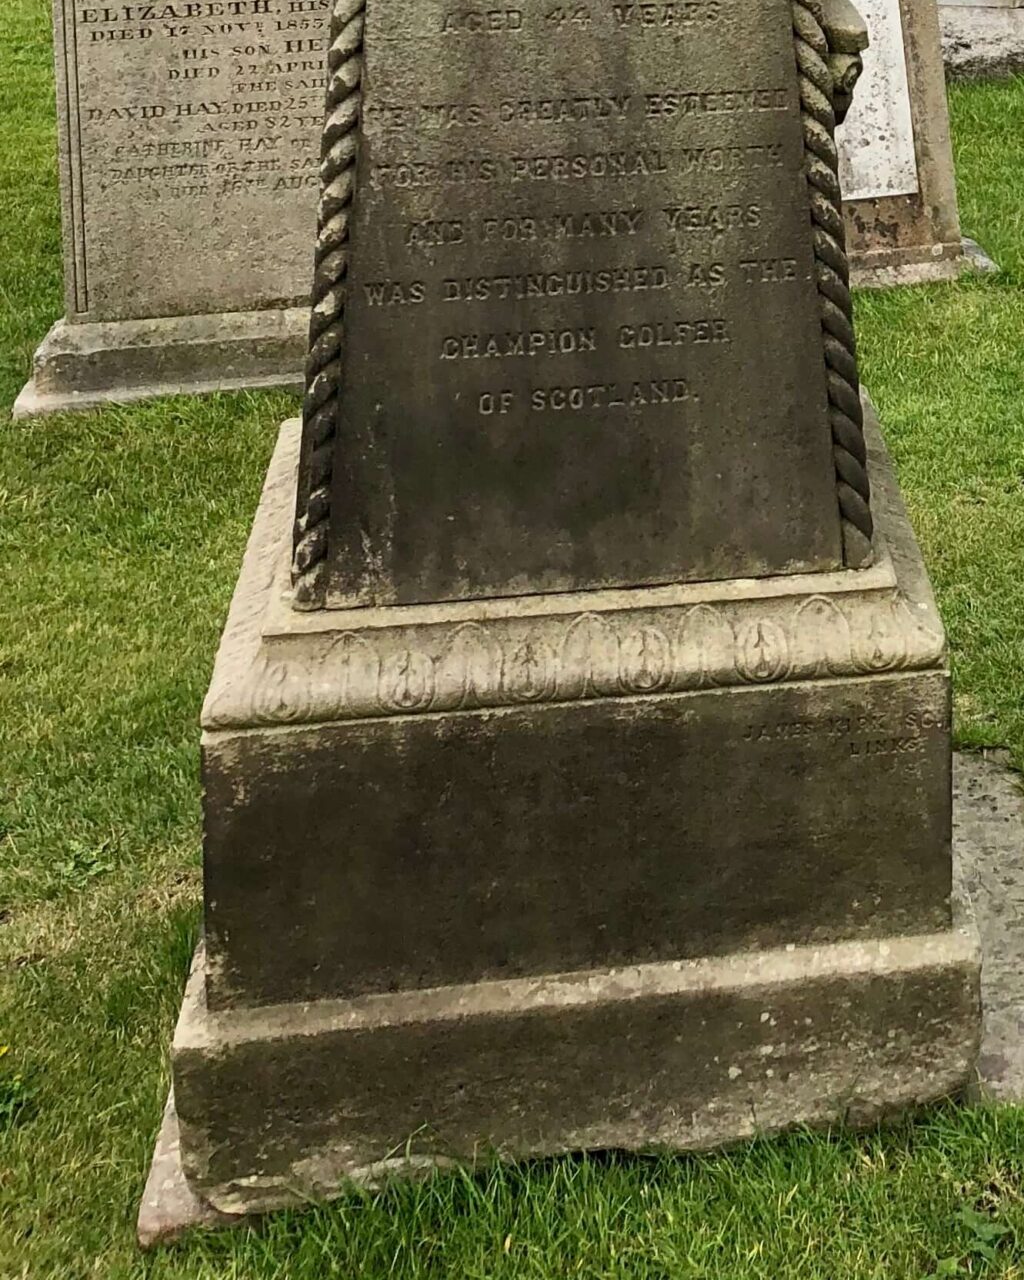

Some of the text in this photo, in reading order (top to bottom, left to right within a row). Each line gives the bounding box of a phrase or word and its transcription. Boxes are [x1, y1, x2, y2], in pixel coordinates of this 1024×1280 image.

[90, 27, 152, 42] DIED
[442, 1, 721, 34] AGED 44 YEARS
[168, 66, 220, 80] DIED
[233, 80, 277, 94] THE
[87, 104, 166, 121] DAVID
[175, 101, 229, 116] HAY
[232, 100, 283, 115] DIED
[366, 89, 789, 132] HE WAS GREATLY ESTEEMED
[115, 140, 224, 158] CATHERINE
[239, 135, 282, 151] HAY
[370, 144, 784, 190] FOR HIS PERSONAL WORTH
[406, 204, 762, 247] AND FOR MANY YEARS
[363, 280, 426, 306] WAS
[442, 266, 669, 301] DISTINGUISHED
[686, 263, 727, 287] AS
[440, 319, 733, 360] CHAMPION GOLFER
[479, 378, 700, 415] OF SCOTLAND.
